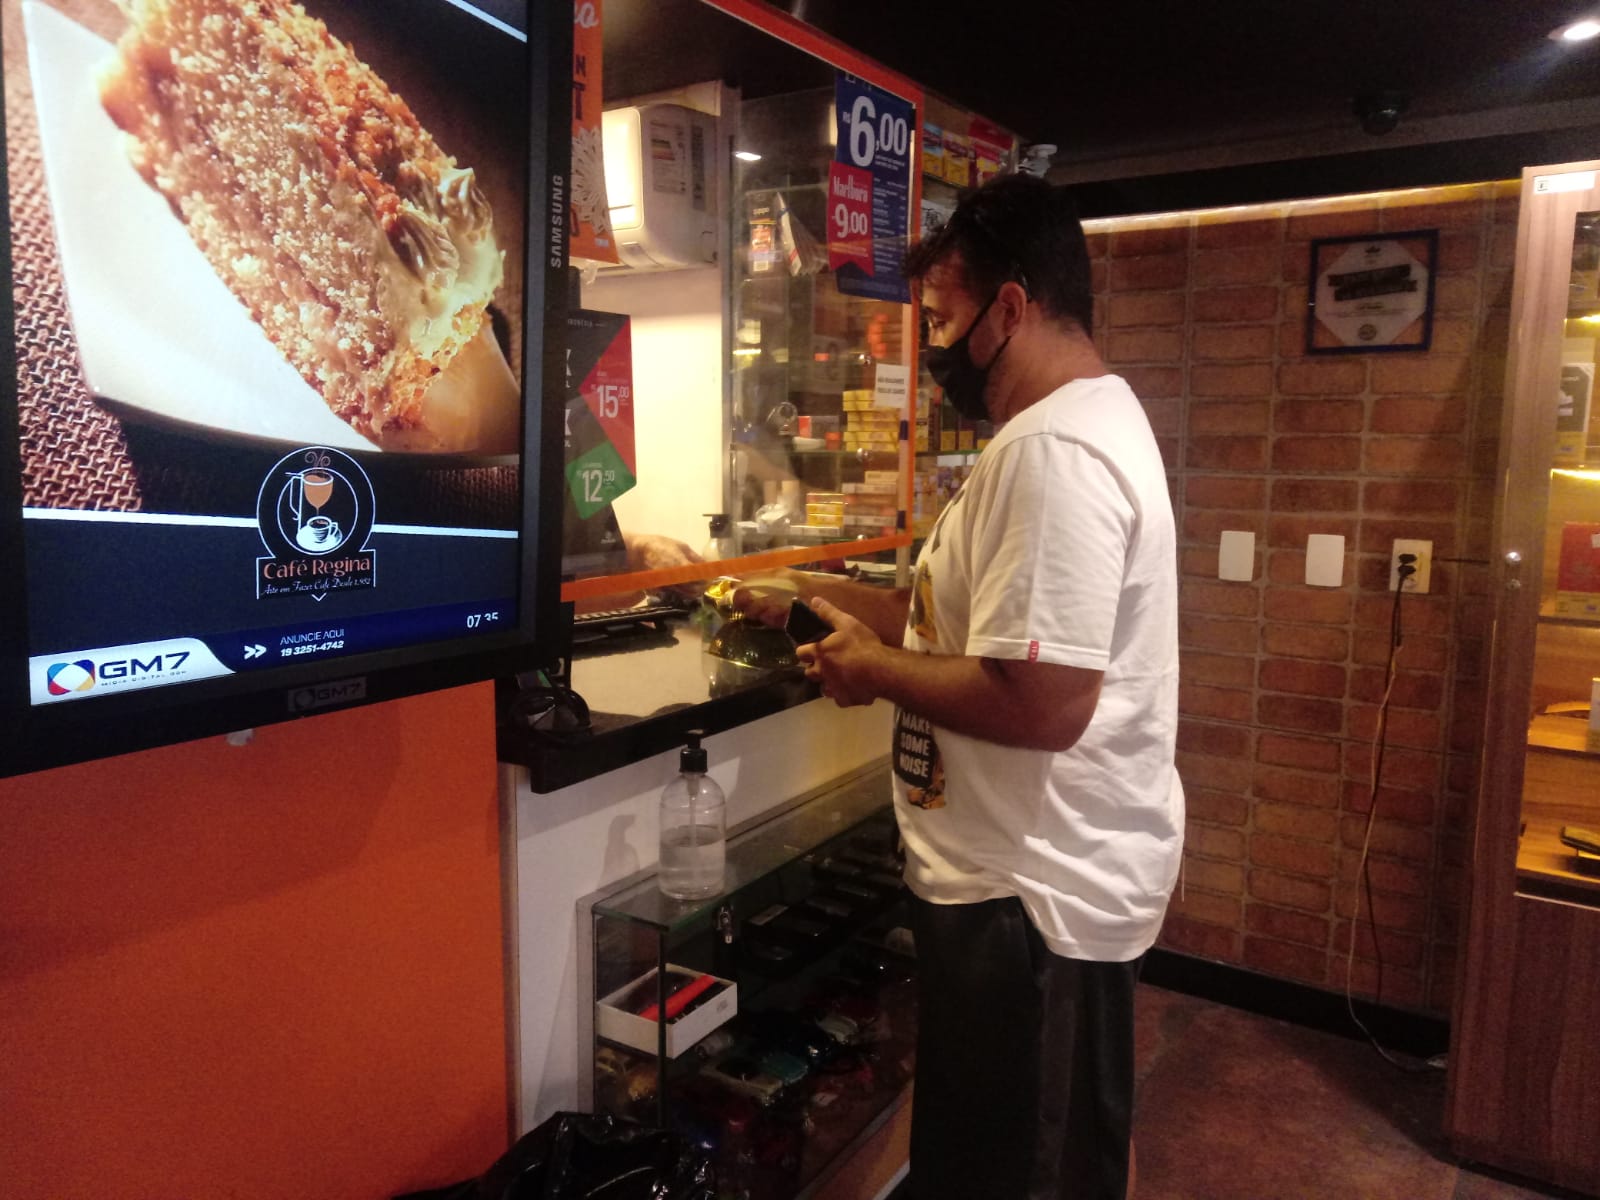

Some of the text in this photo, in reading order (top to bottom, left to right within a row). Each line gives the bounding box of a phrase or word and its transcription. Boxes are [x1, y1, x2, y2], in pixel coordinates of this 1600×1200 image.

[833, 174, 869, 203] Marlboro
[551, 174, 564, 268] SAMSUNG
[263, 556, 371, 580] Café Regina
[280, 629, 345, 645] ANUNCIE AQUI
[281, 640, 345, 657] 19 3251-4742
[99, 651, 191, 680] GM7
[902, 711, 931, 734] MAKE
[900, 732, 931, 756] SOME
[899, 752, 930, 778] NOISE
